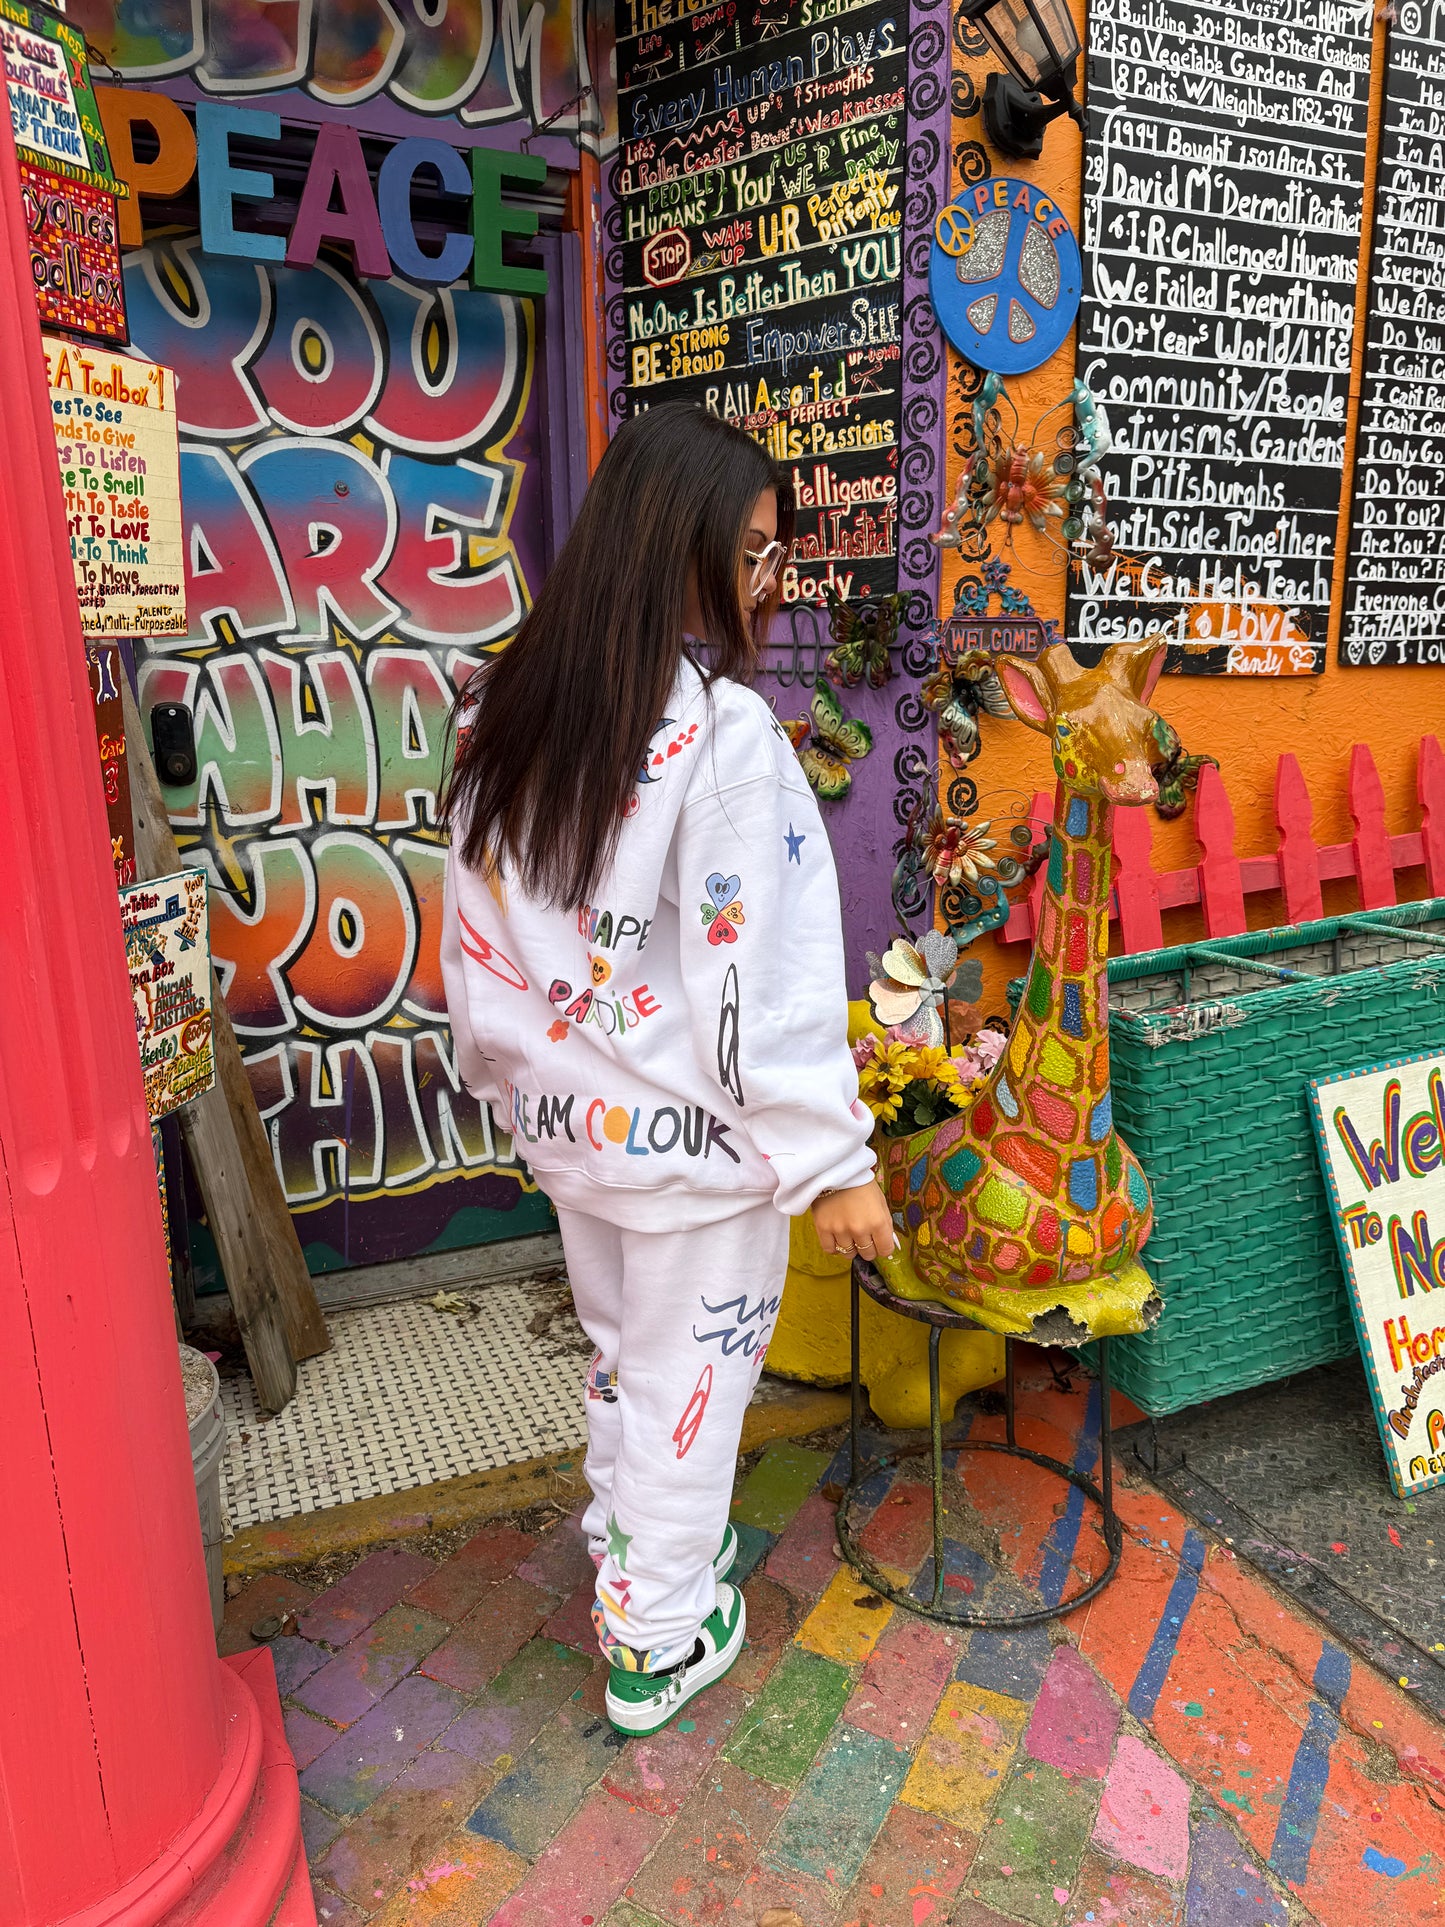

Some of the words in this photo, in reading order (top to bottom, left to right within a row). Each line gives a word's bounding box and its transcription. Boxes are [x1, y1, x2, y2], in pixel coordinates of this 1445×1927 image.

[1118, 0, 1187, 45] Building
[1193, 13, 1223, 39] 30+
[1224, 18, 1276, 52] Blocks
[1276, 28, 1322, 60] Street
[1322, 36, 1371, 70] Gardens
[632, 88, 705, 138] Every
[713, 55, 803, 110] Human
[811, 17, 898, 76] Plays
[805, 65, 875, 104] Strengths
[1117, 33, 1142, 58] 50
[1230, 48, 1307, 92] Gardens
[1317, 68, 1356, 99] And
[1116, 62, 1130, 93] 8
[1134, 67, 1178, 103] Parks
[1292, 97, 1354, 131] 1982-94
[51, 103, 77, 132] YOU
[1399, 107, 1426, 134] I'm
[30, 118, 83, 158] THINK
[784, 142, 807, 167] US
[839, 123, 880, 155] Fine
[844, 134, 900, 180] Dandy
[1113, 119, 1159, 148] 1994
[1166, 126, 1234, 173] Bought
[1240, 144, 1275, 169] 1501
[1277, 144, 1318, 179] Arch
[1320, 153, 1351, 181] St.
[1396, 136, 1424, 166] I'm
[620, 168, 632, 191] A
[638, 157, 680, 188] Roller
[683, 139, 744, 174] Coaster
[780, 162, 816, 200] WE
[1085, 155, 1104, 183] 28
[1113, 162, 1179, 207] David
[97, 86, 549, 295] PEACE
[648, 171, 714, 212] PEOPLE
[807, 168, 889, 227] Perfectly
[1392, 168, 1421, 202] My
[974, 181, 1068, 240] PEACE
[1399, 200, 1439, 229] Will
[650, 243, 685, 269] STOP
[702, 218, 754, 249] WAKE
[720, 244, 746, 267] UP
[1292, 233, 1359, 281] Humans
[1383, 227, 1410, 253] I'm
[692, 287, 717, 326] Is
[719, 273, 788, 320] Better
[778, 261, 837, 305] Then
[841, 232, 902, 289] YOU
[1099, 262, 1149, 303] We
[1155, 266, 1219, 312] Failed
[1226, 274, 1354, 342] Everything
[1377, 286, 1411, 315] We
[670, 324, 730, 357] STRONG
[745, 317, 848, 378] Empower
[1093, 310, 1149, 350] 40+
[1150, 313, 1210, 356] Year's
[1382, 321, 1408, 347] Do
[1415, 325, 1442, 351] You
[632, 342, 667, 387] BE
[671, 350, 726, 378] PROUD
[1393, 353, 1429, 378] Can't
[754, 358, 847, 414] Assorted
[1389, 383, 1425, 408] Can't
[73, 397, 93, 417] To
[95, 401, 123, 424] See
[743, 409, 780, 430] 100%
[1382, 409, 1418, 432] Can't
[83, 421, 101, 442] To
[103, 426, 136, 450] Give
[811, 413, 895, 455] Passions
[1250, 420, 1346, 463] Gardens
[1380, 438, 1418, 469] Only
[1422, 438, 1444, 465] Go
[75, 443, 96, 466] To
[100, 446, 147, 475] Listen
[78, 467, 99, 490] To
[103, 470, 145, 497] Smell
[1130, 454, 1286, 526] Pittsburghs
[1365, 468, 1390, 495] Do
[87, 491, 105, 515] To
[107, 494, 150, 520] Taste
[1363, 500, 1388, 526] Do
[1394, 501, 1441, 528] You?
[87, 514, 106, 539] To
[110, 518, 151, 543] LOVE
[145, 436, 522, 651] ARE
[1224, 511, 1332, 573] Together
[1360, 529, 1390, 553] Are
[82, 536, 102, 561] To
[107, 539, 149, 565] Think
[1356, 558, 1387, 580] Can
[78, 560, 97, 584] To
[101, 562, 140, 586] Move
[782, 562, 854, 604] Body
[1081, 557, 1131, 598] We
[1140, 556, 1191, 599] Can
[1199, 558, 1260, 614] Help
[1263, 559, 1329, 602] Teach
[1355, 584, 1429, 613] Everyone
[949, 627, 1039, 653] WELCOME
[1078, 601, 1189, 643] Respect
[1220, 603, 1301, 643] LOVE
[1226, 645, 1285, 677] Randy
[136, 649, 486, 833] WHA
[577, 903, 653, 951] ESCAPE
[156, 972, 193, 998] HUMAN
[1341, 1200, 1384, 1250] To
